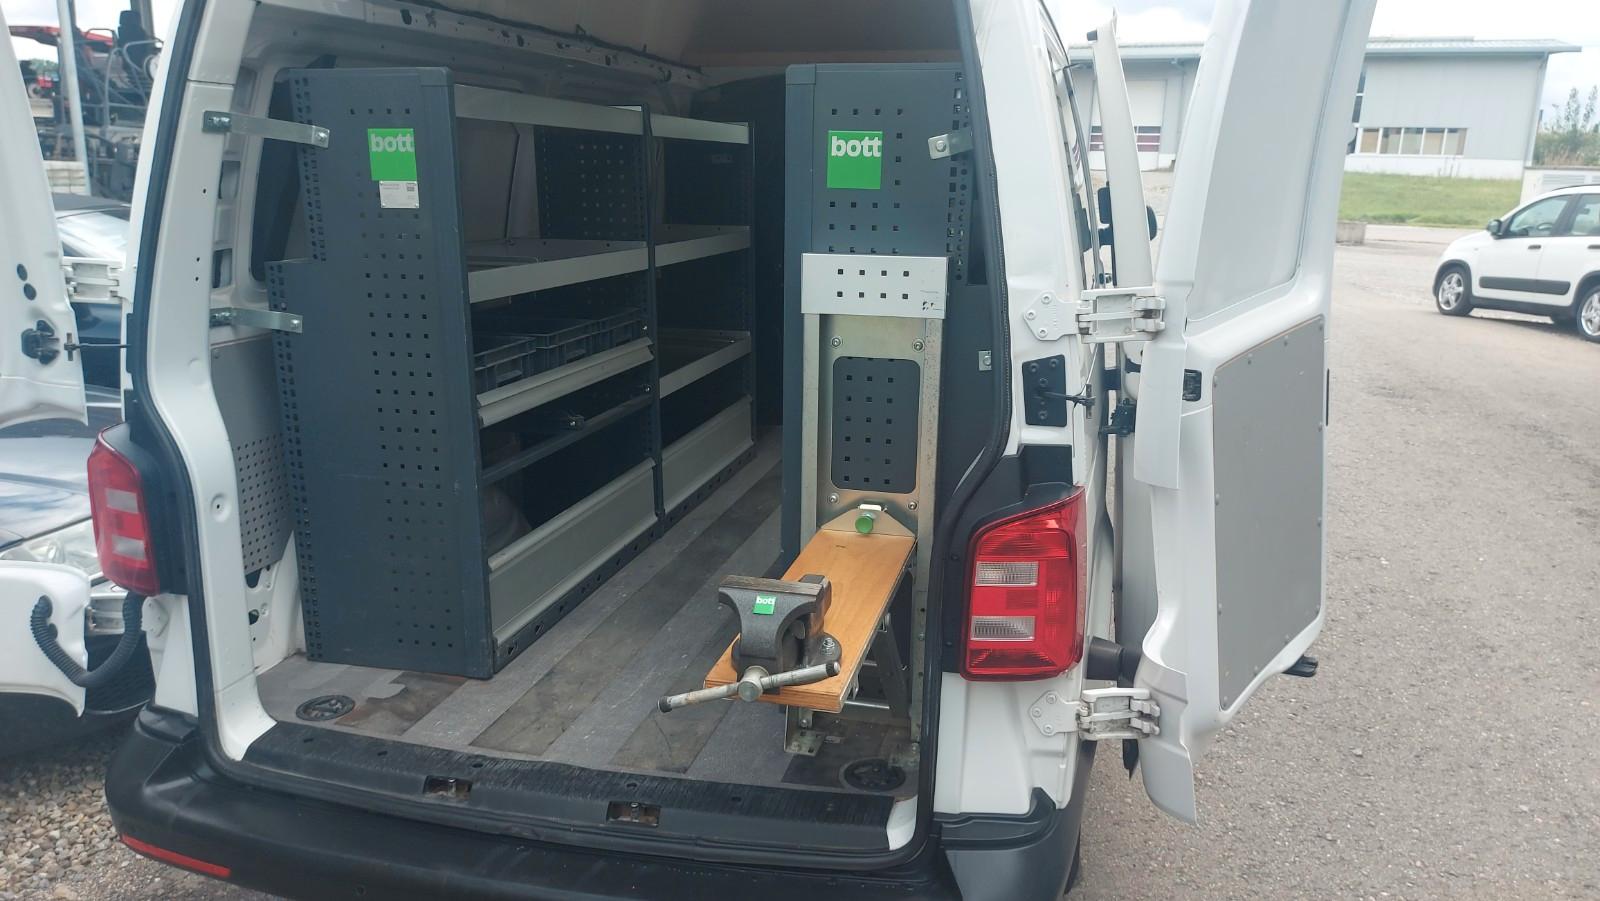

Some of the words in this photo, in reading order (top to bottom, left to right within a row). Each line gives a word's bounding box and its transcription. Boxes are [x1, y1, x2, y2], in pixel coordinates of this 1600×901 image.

[370, 133, 415, 152] bott
[832, 136, 882, 157] bott
[755, 595, 776, 605] bott
